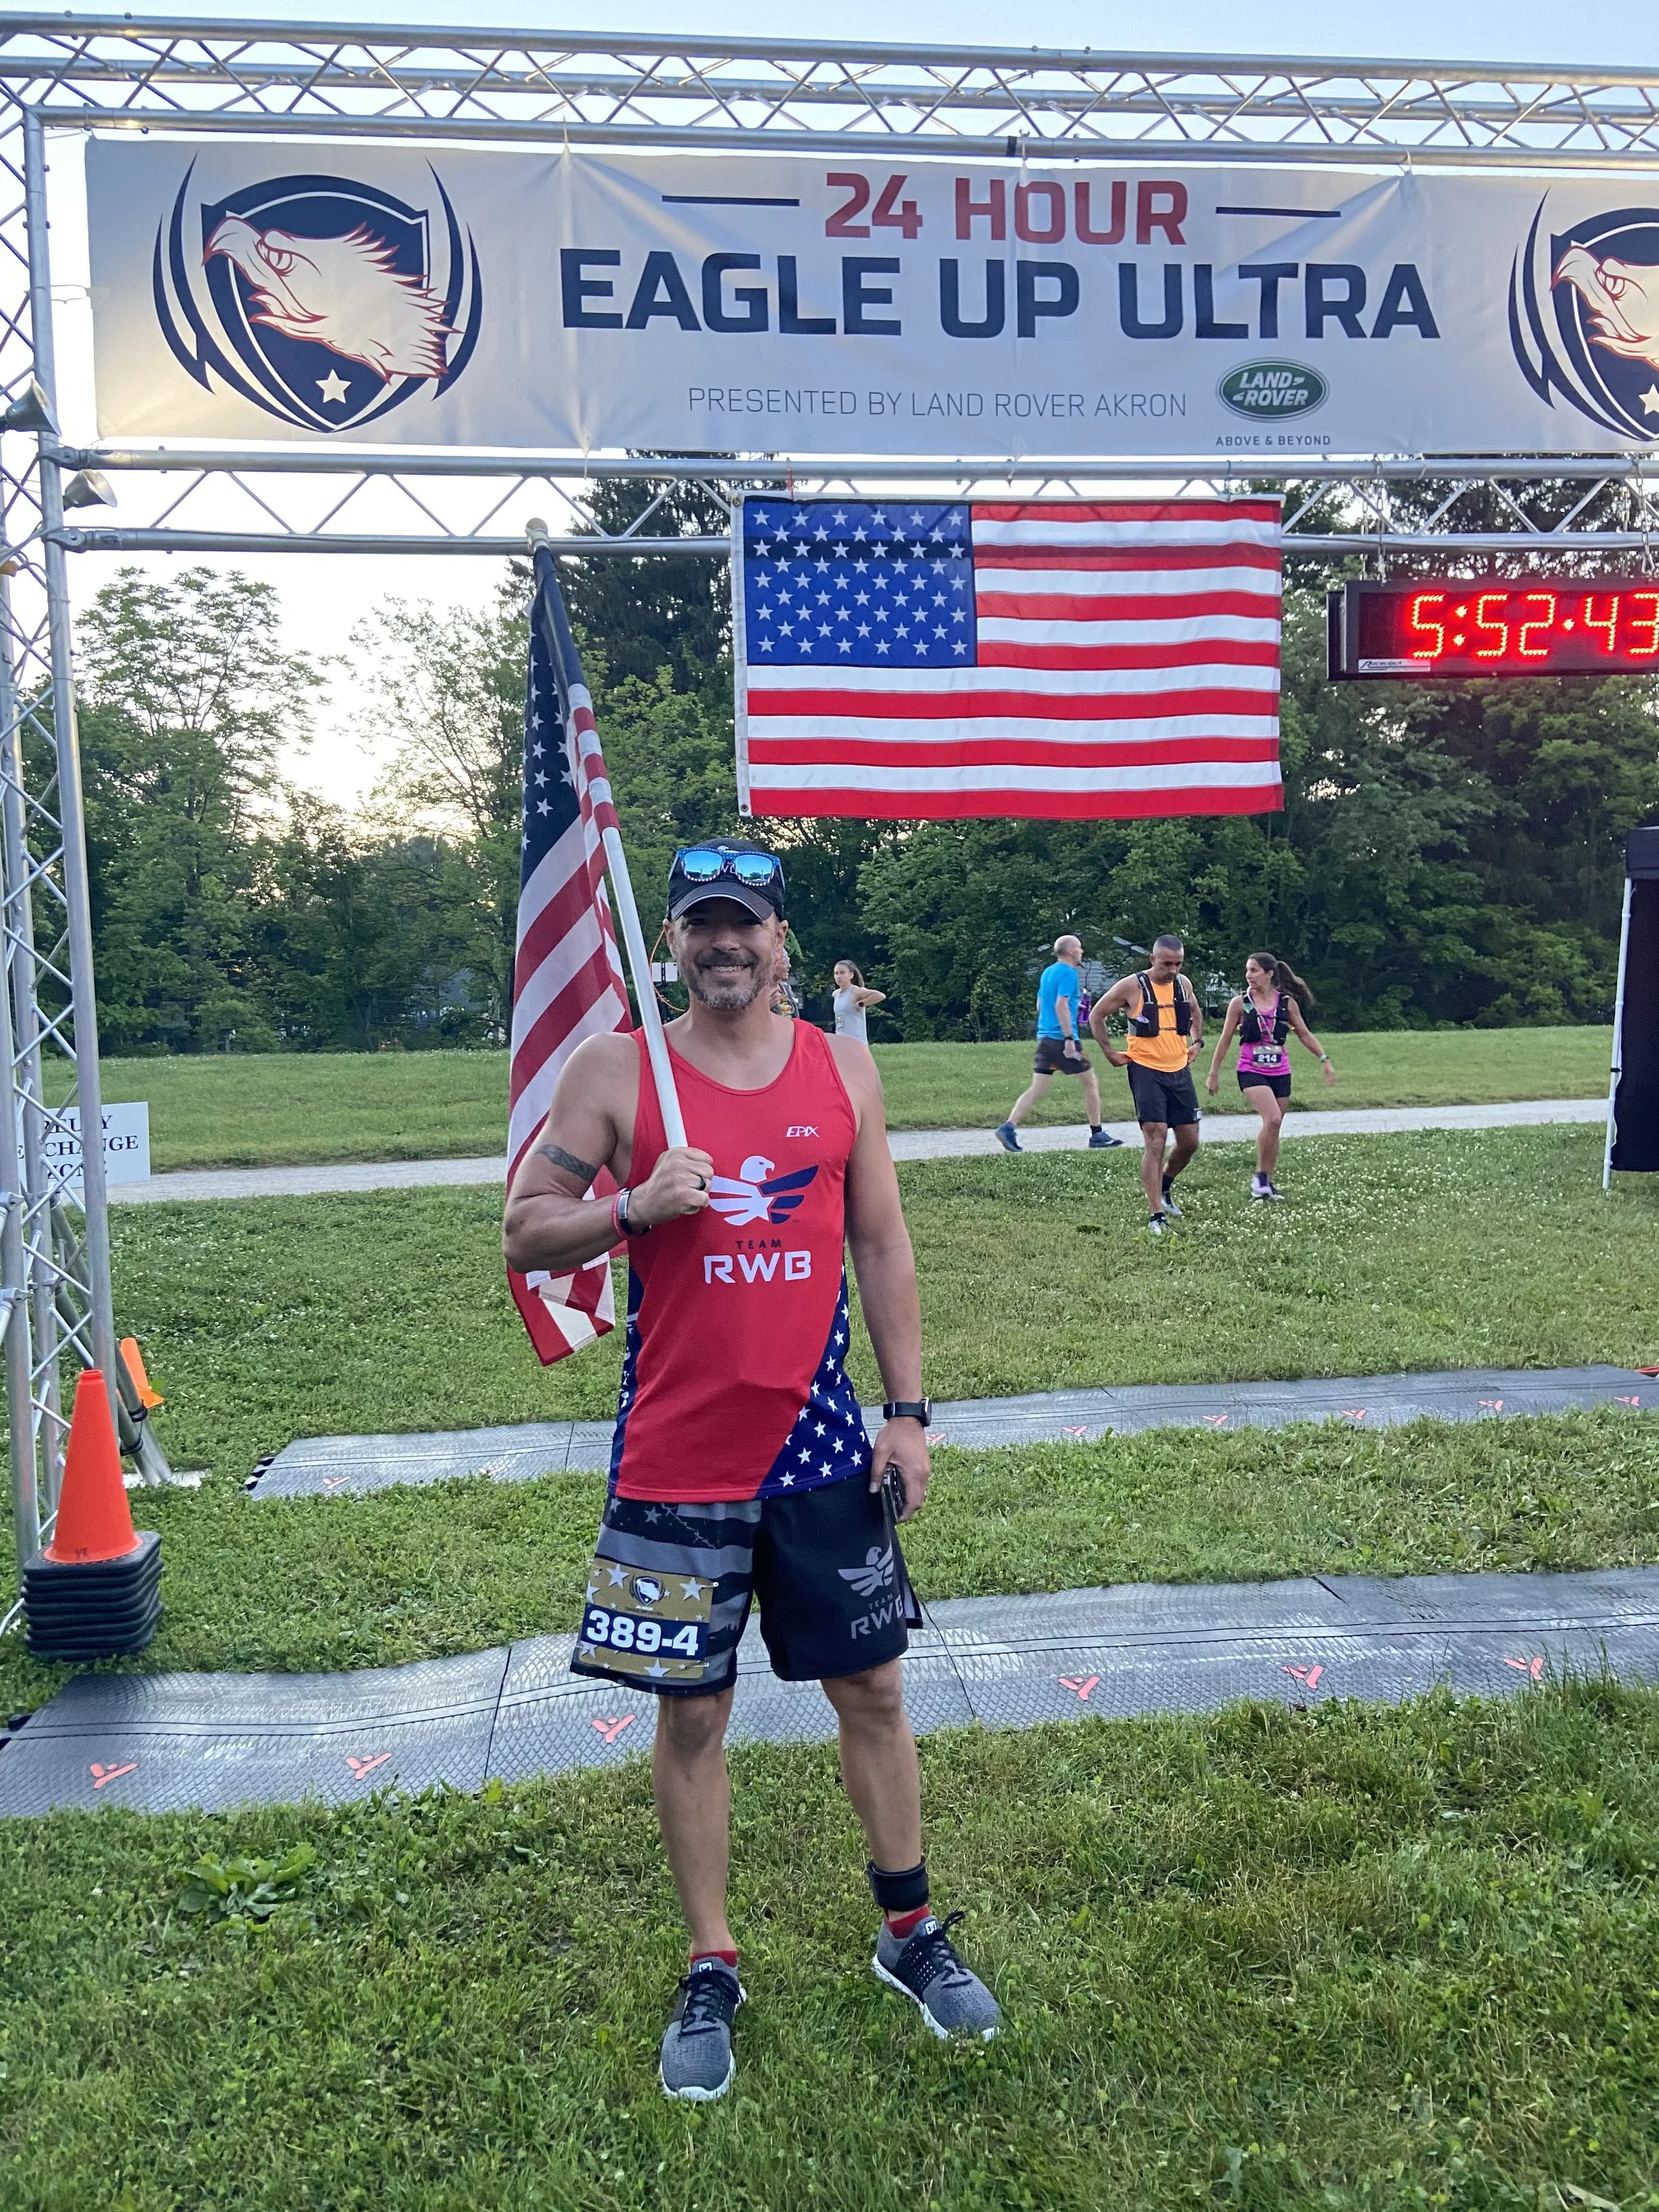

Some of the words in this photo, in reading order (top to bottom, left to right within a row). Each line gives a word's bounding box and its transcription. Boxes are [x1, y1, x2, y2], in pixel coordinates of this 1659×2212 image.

[825, 172, 923, 240] 24
[955, 177, 1188, 246] HOUR
[560, 248, 902, 335] EAGLE
[939, 258, 1080, 338] UP
[1118, 262, 1441, 339] ULTRA
[1238, 372, 1293, 389] LAND
[689, 388, 857, 415] PRESENTED
[868, 392, 902, 415] BY
[912, 392, 984, 417] LAND
[995, 394, 1085, 418] ROVER
[1094, 394, 1187, 417] AKRON
[1243, 389, 1309, 407] ROVER
[1216, 436, 1260, 447] ABOVE
[1265, 435, 1273, 446] &
[1278, 435, 1331, 446] BEYOND
[1258, 1054, 1277, 1063] 214
[737, 1238, 782, 1249] TEAM
[703, 1250, 811, 1284] RWB
[586, 1609, 698, 1656] 389-4
